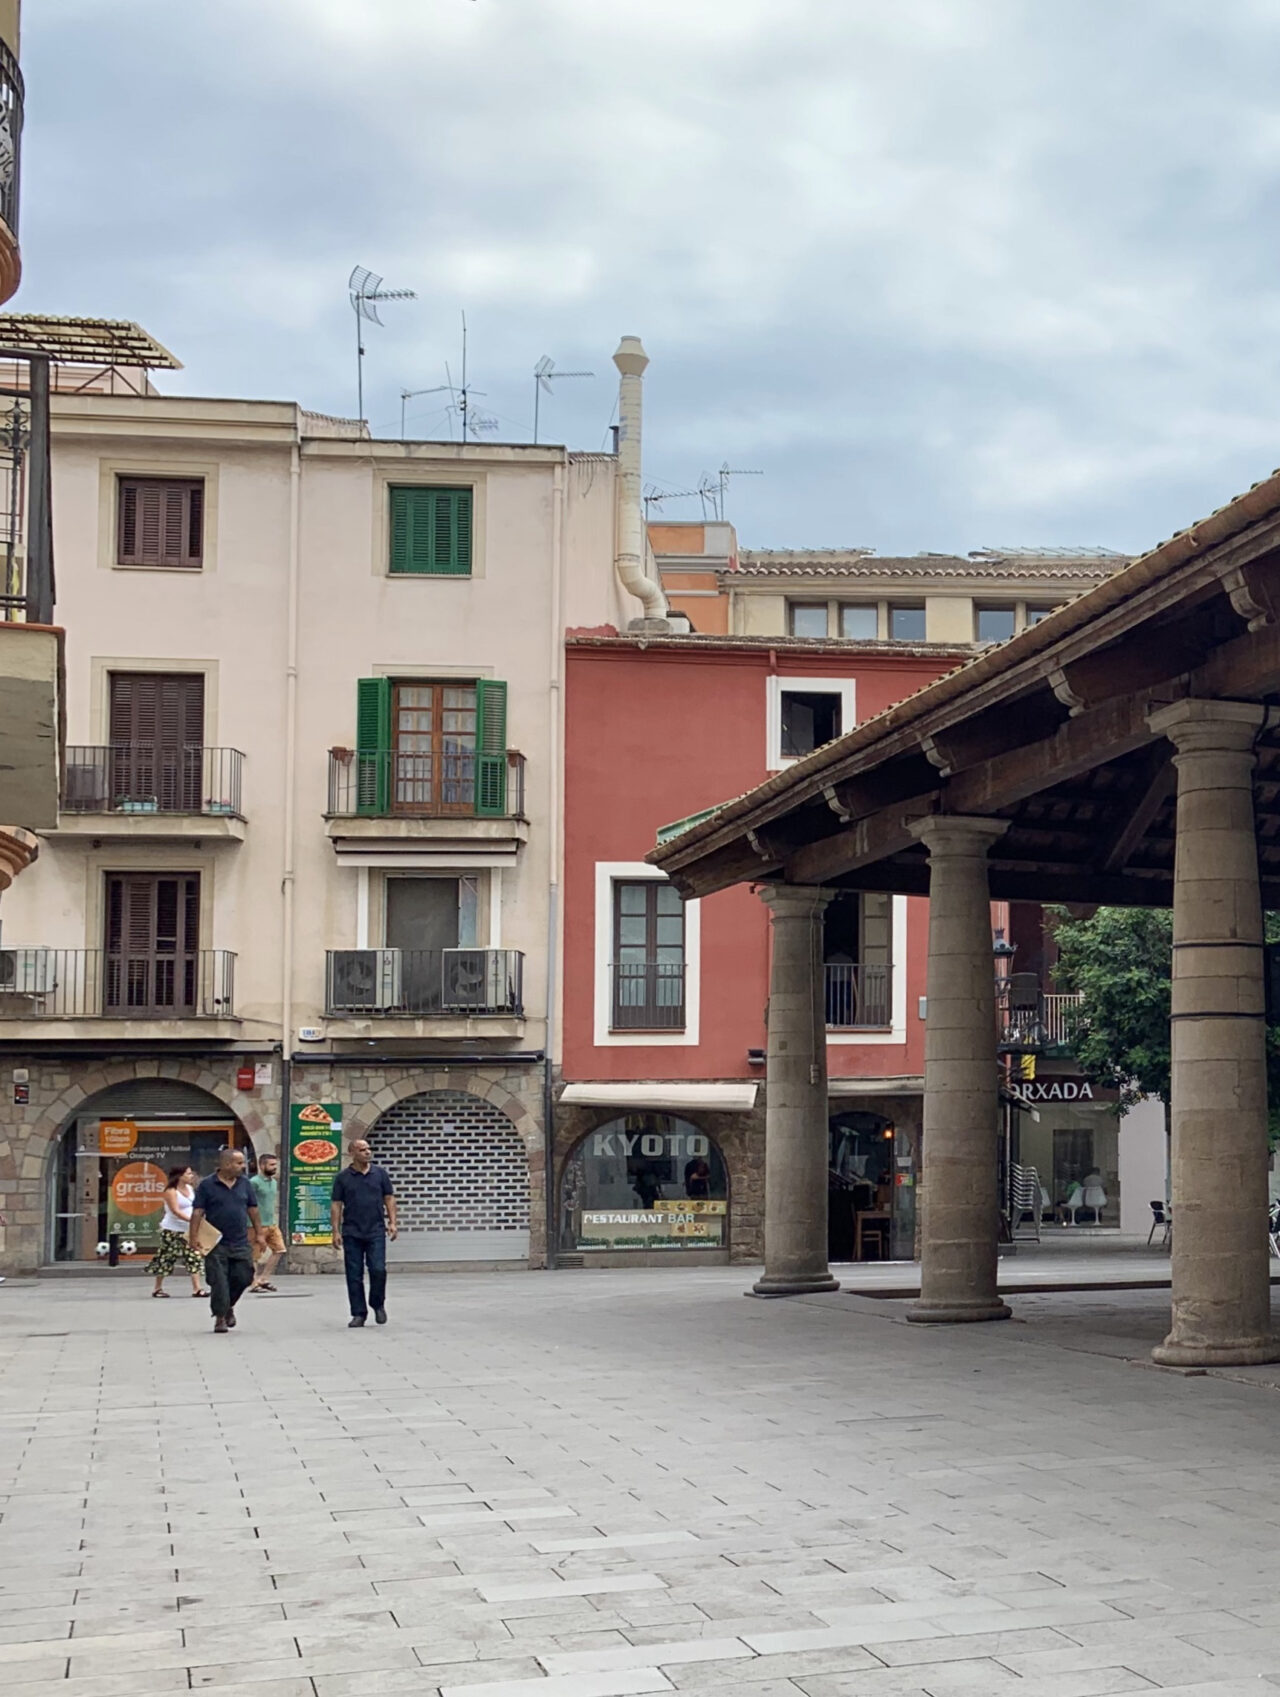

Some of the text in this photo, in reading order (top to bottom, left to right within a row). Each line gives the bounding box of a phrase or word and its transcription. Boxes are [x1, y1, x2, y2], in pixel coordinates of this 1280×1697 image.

[104, 1127, 131, 1135] Fibra
[593, 1134, 709, 1157] KYOTO
[129, 1152, 155, 1160] Orange
[116, 1179, 164, 1196] gratis
[668, 1213, 695, 1224] BAR
